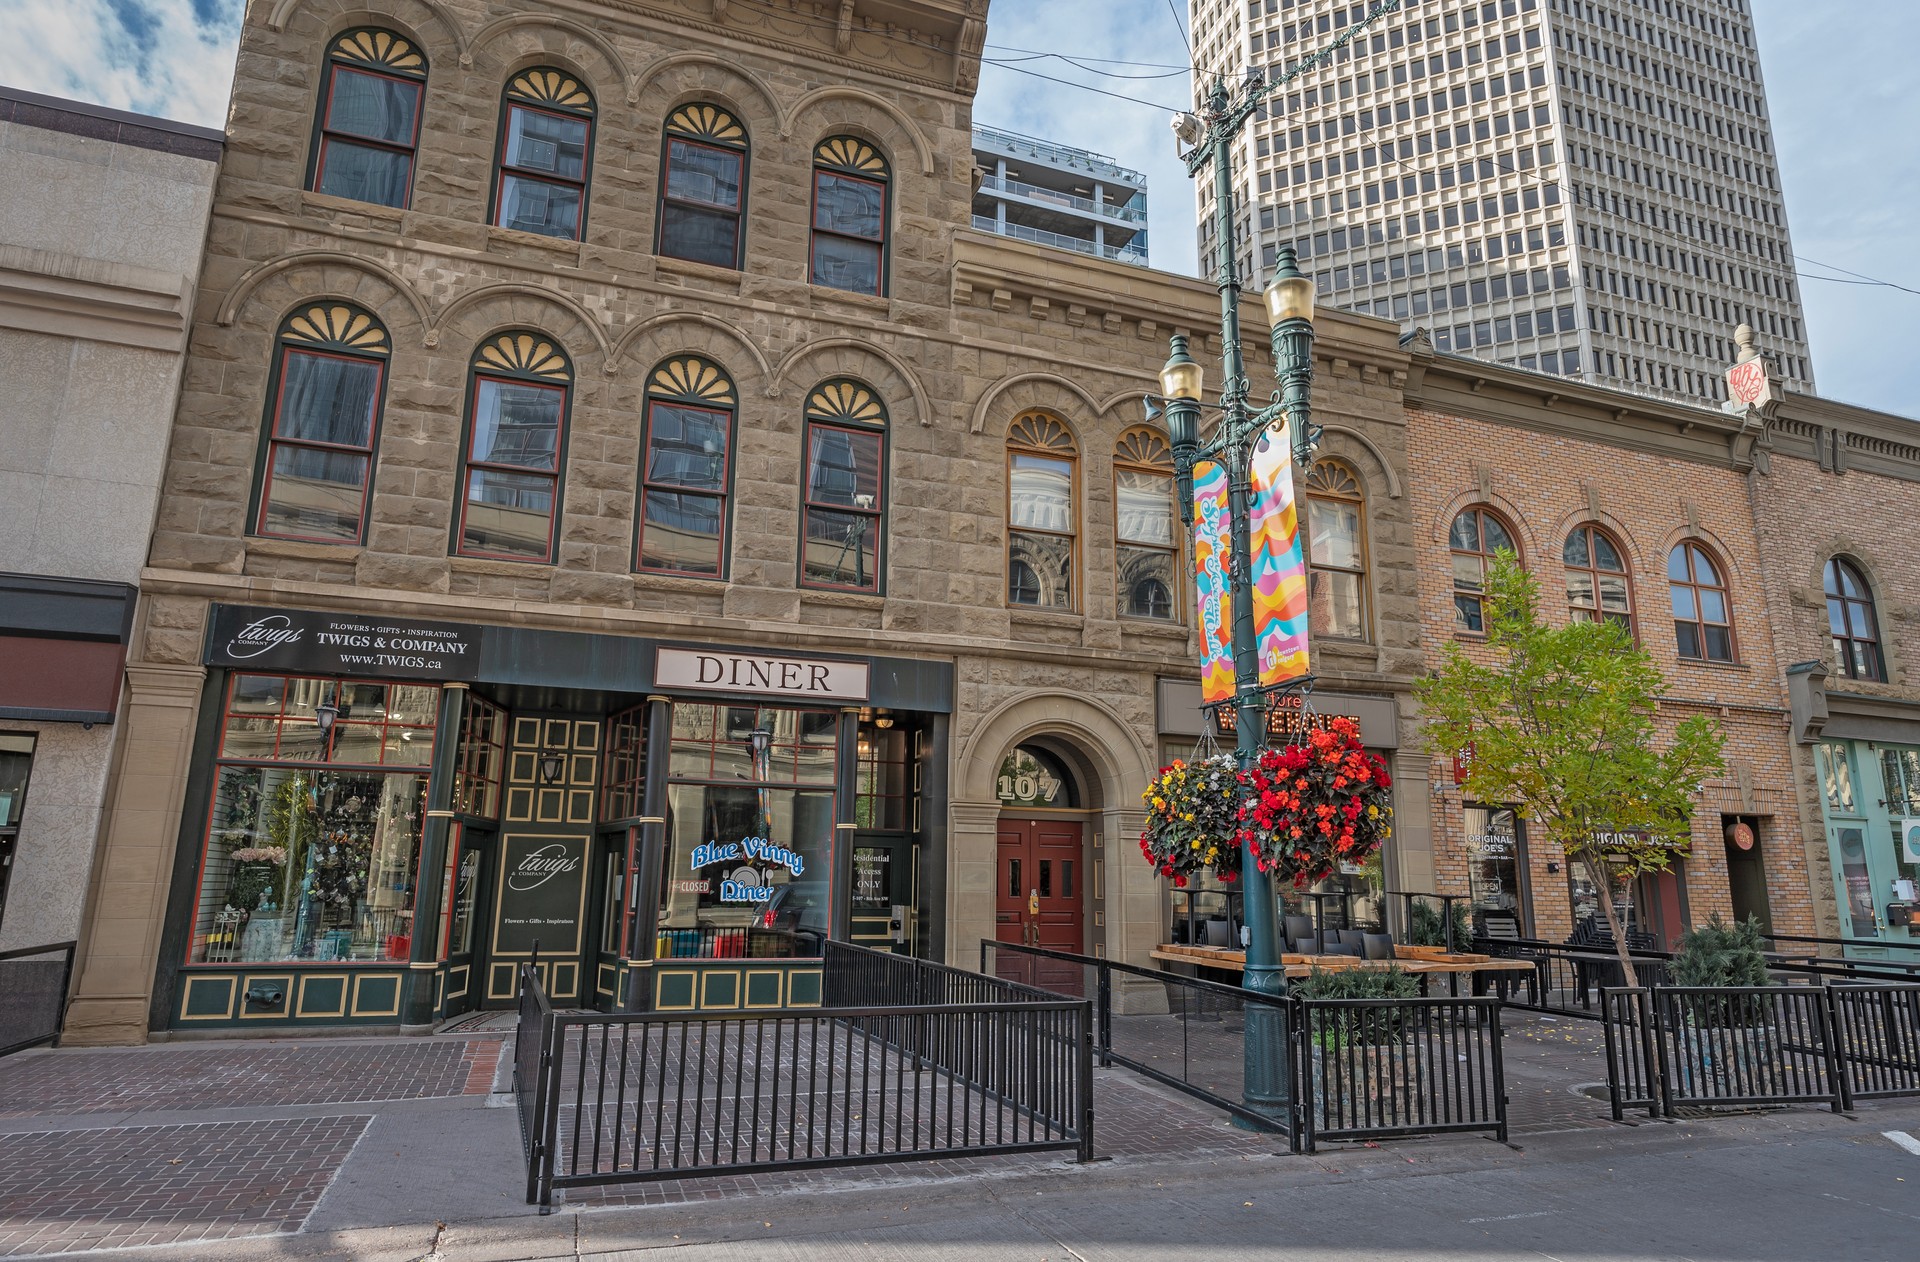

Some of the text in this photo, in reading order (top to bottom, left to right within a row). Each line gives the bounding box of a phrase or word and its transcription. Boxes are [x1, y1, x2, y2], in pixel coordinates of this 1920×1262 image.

[1200, 496, 1224, 662] Stephen Avenue Walk
[227, 615, 304, 658] twigs
[330, 622, 458, 639] FLOWERS GIFTS INSPIRATION
[317, 632, 468, 655] TWIGS & COMPANY
[1278, 645, 1300, 656] downtown
[340, 652, 442, 669] www.TWIGS.ca
[1278, 655, 1294, 664] calgary
[695, 656, 832, 692] DINER
[1266, 692, 1302, 708] ture
[998, 775, 1061, 802] 107
[1468, 834, 1513, 844] ORIGINAL
[691, 836, 805, 877] Blue Vinny
[1479, 844, 1504, 853] JOE'S
[508, 843, 579, 891] twigs
[681, 881, 709, 892] CLOSED
[720, 879, 774, 902] Diner
[857, 880, 880, 888] ONLY
[1481, 882, 1498, 891] OPEN
